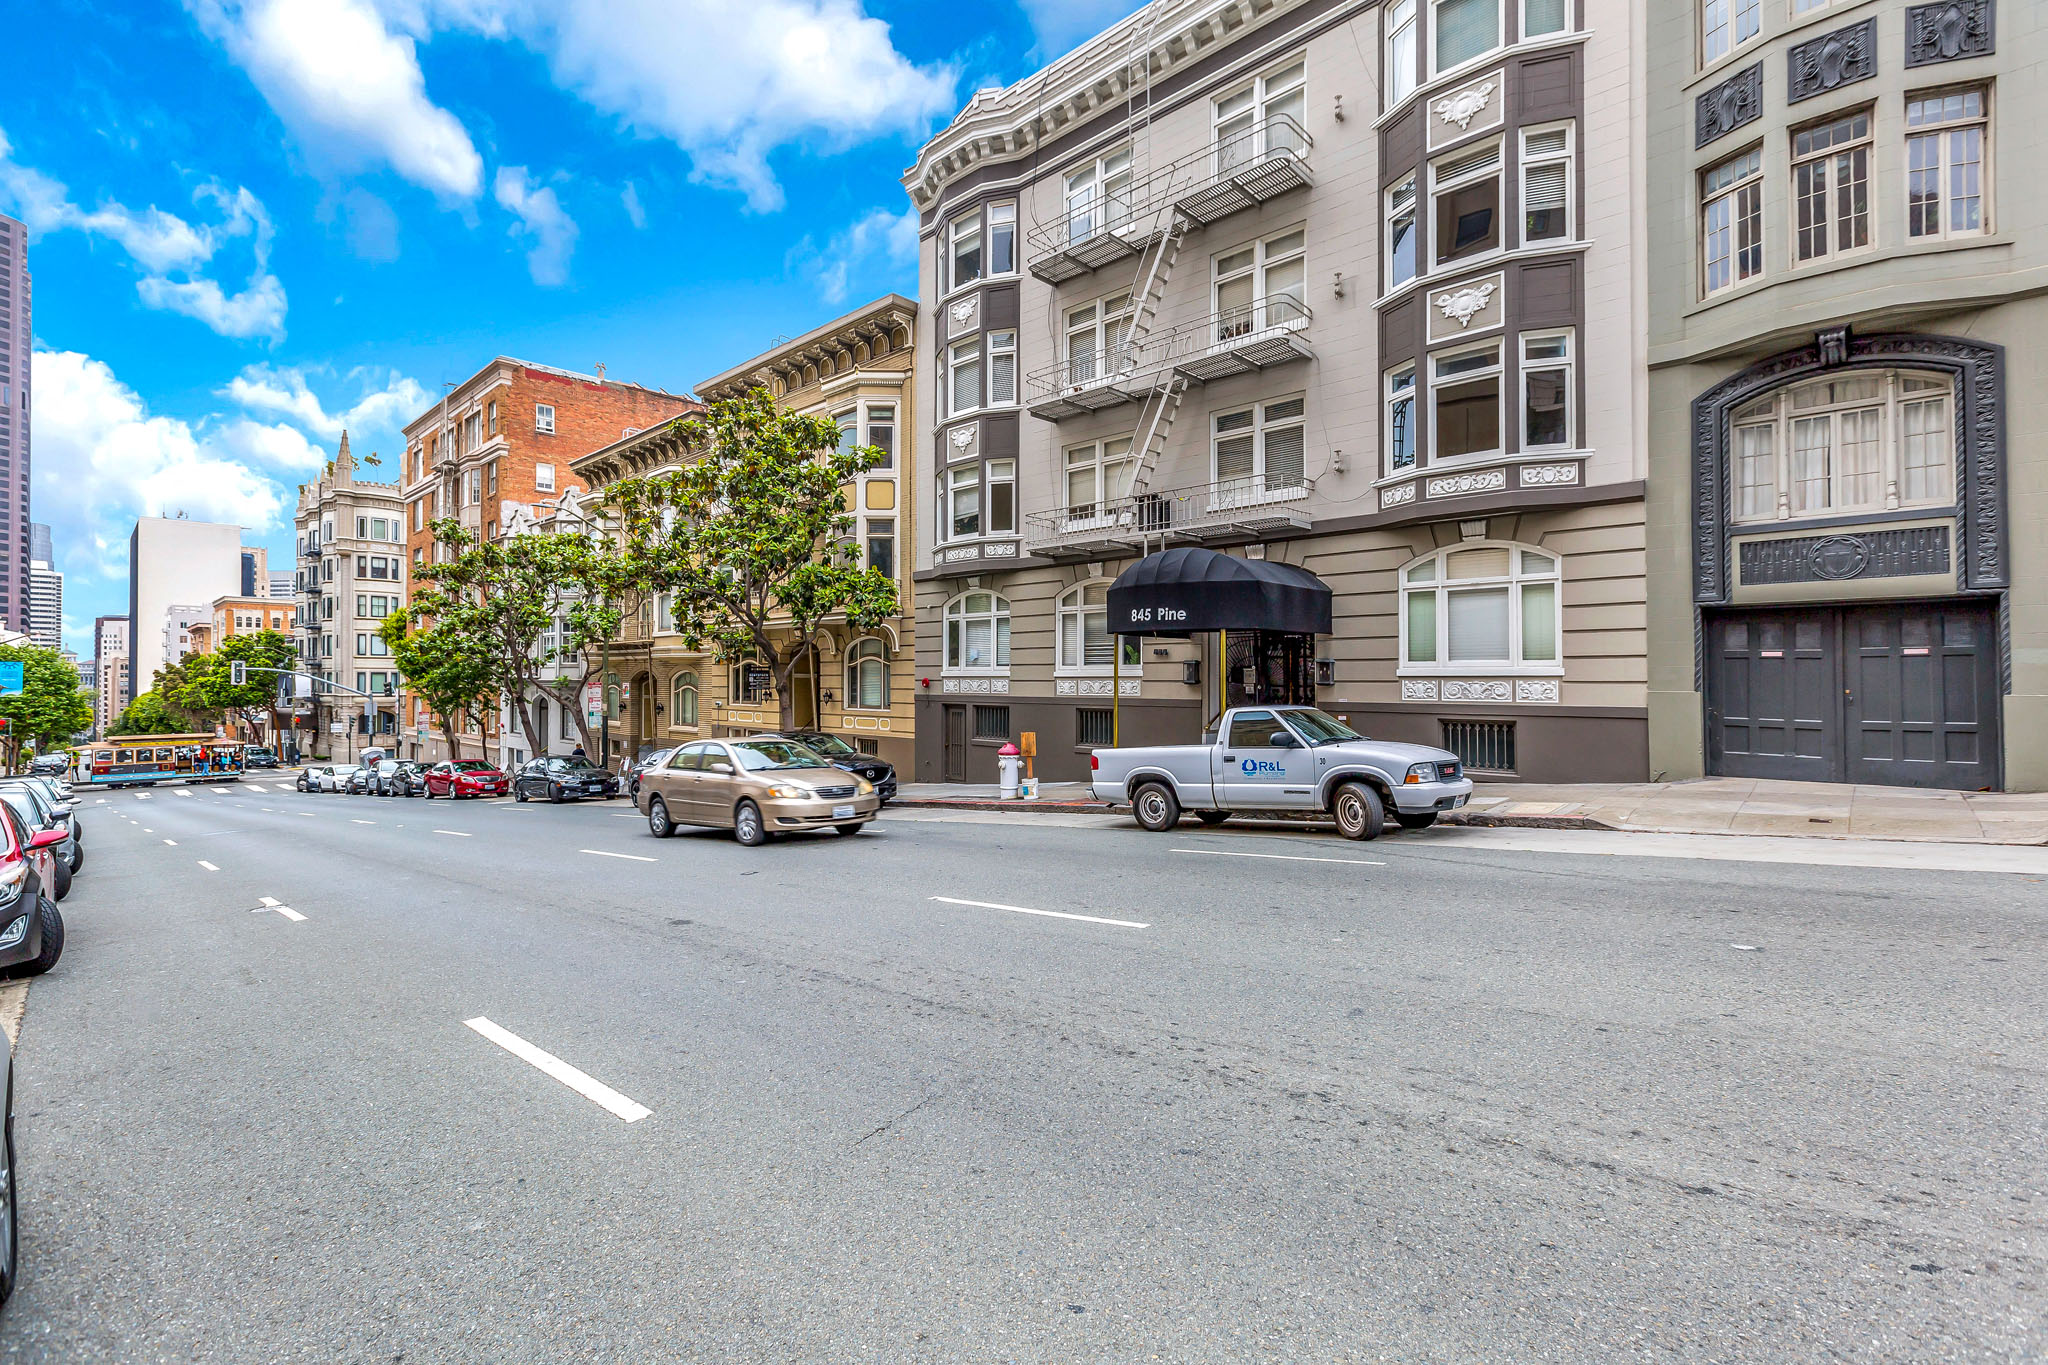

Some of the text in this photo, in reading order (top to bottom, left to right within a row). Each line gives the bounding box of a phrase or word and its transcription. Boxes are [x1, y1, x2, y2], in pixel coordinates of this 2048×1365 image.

[1131, 607, 1187, 622] 845 Pine
[1259, 761, 1285, 771] R&L
